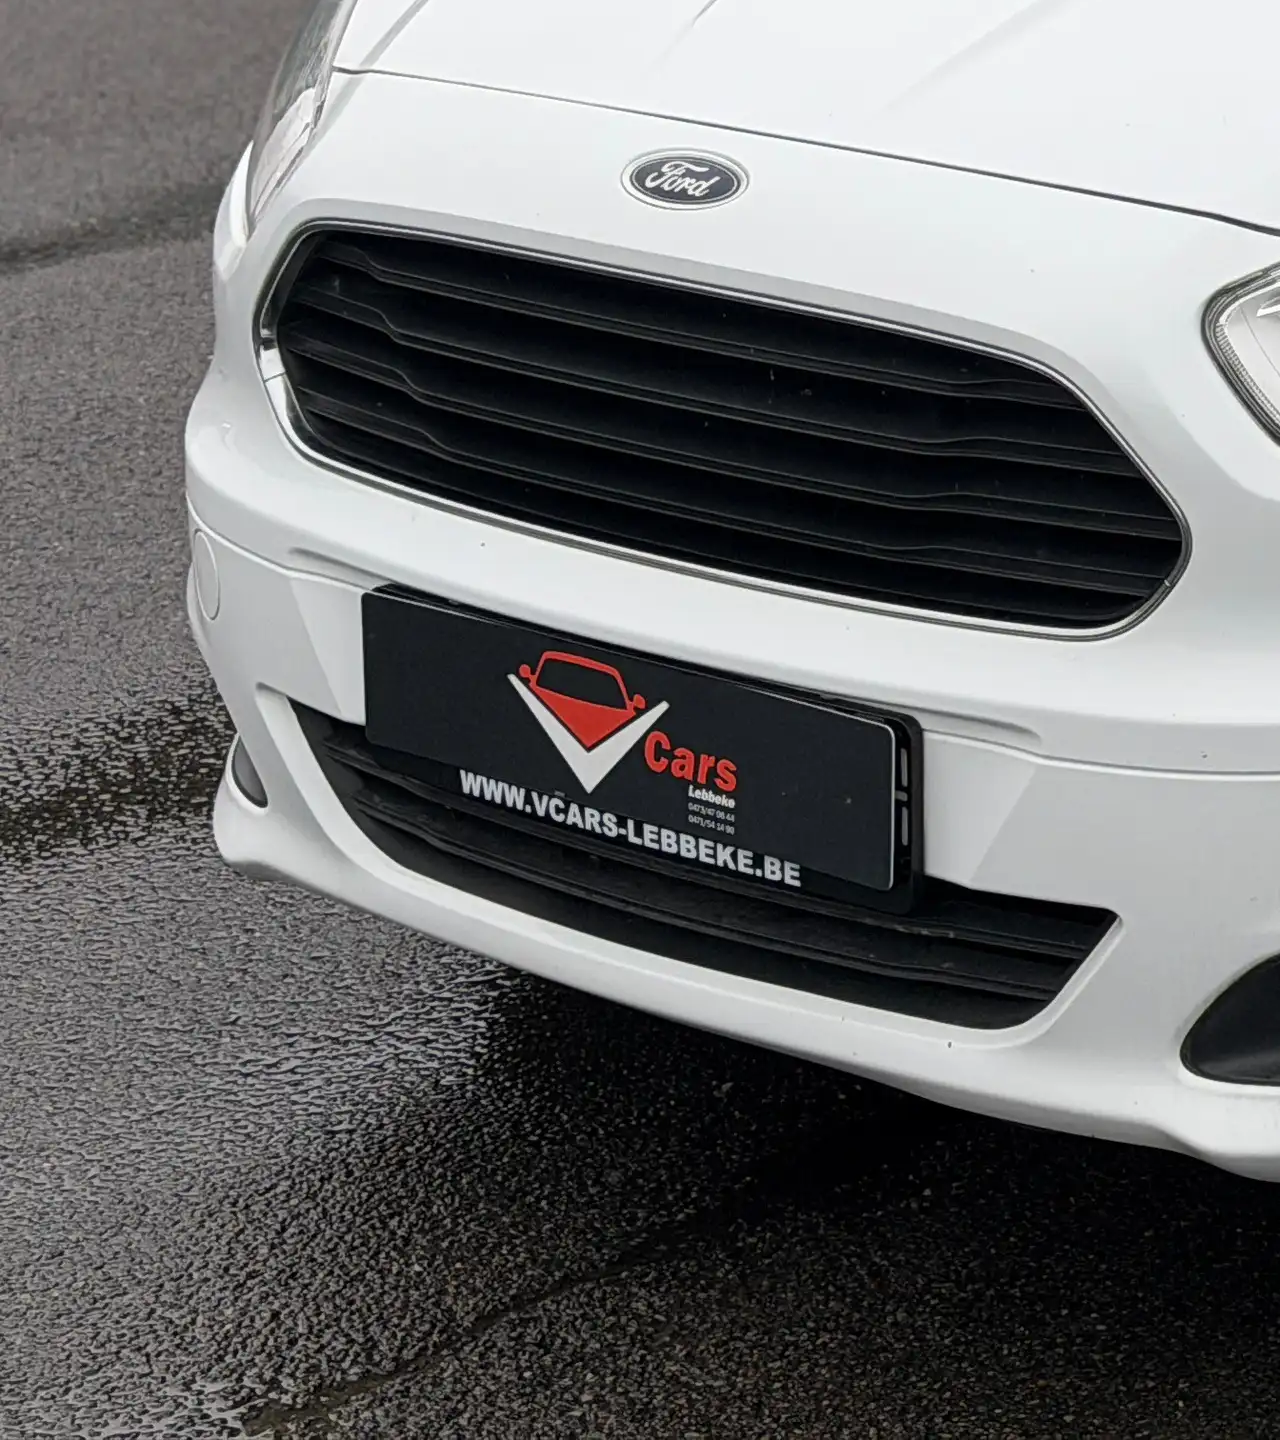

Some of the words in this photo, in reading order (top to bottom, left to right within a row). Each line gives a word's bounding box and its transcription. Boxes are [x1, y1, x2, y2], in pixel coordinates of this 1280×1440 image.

[645, 161, 720, 197] Ford
[644, 730, 738, 792] Cars
[687, 784, 736, 809] Lebbeke
[459, 768, 802, 888] WWW.VCARS-LEBBEKE.BE
